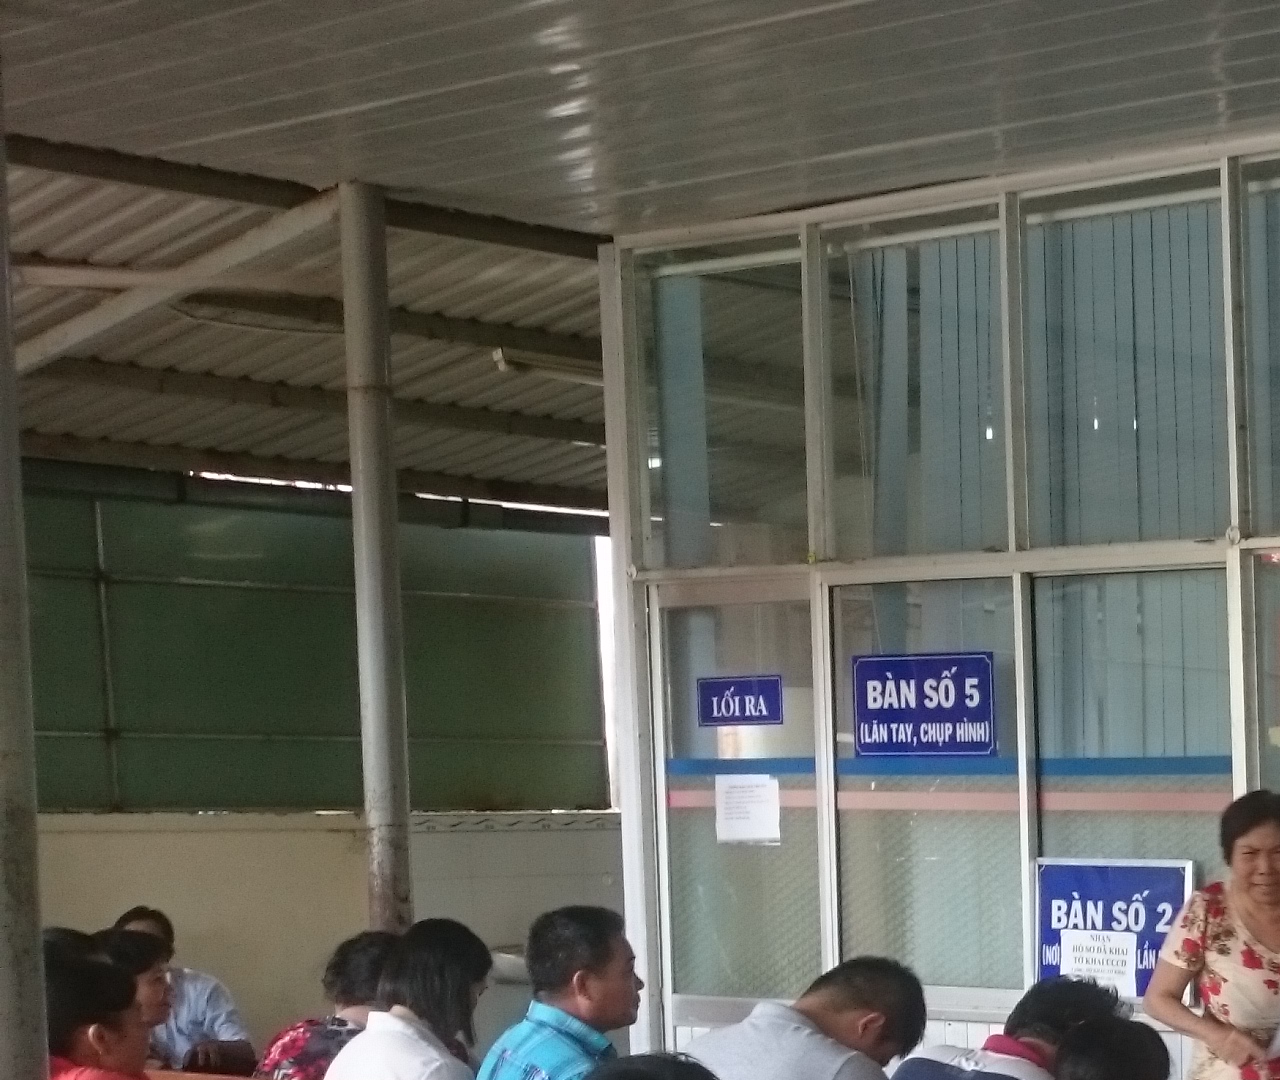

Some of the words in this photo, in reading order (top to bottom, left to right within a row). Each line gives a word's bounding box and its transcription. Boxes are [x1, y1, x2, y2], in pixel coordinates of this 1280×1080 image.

[712, 686, 740, 717] LỐI
[745, 695, 768, 716] RA
[867, 672, 916, 709] BÀN
[923, 667, 957, 709] SỐ
[965, 679, 980, 708] 5
[890, 723, 917, 747] TAY,
[920, 723, 953, 747] CHỤP
[956, 718, 990, 743] HÌNH)
[1052, 892, 1103, 930] BÀN
[1111, 890, 1150, 932] SỐ
[1155, 902, 1173, 932] 2
[1109, 946, 1128, 956] KHAI
